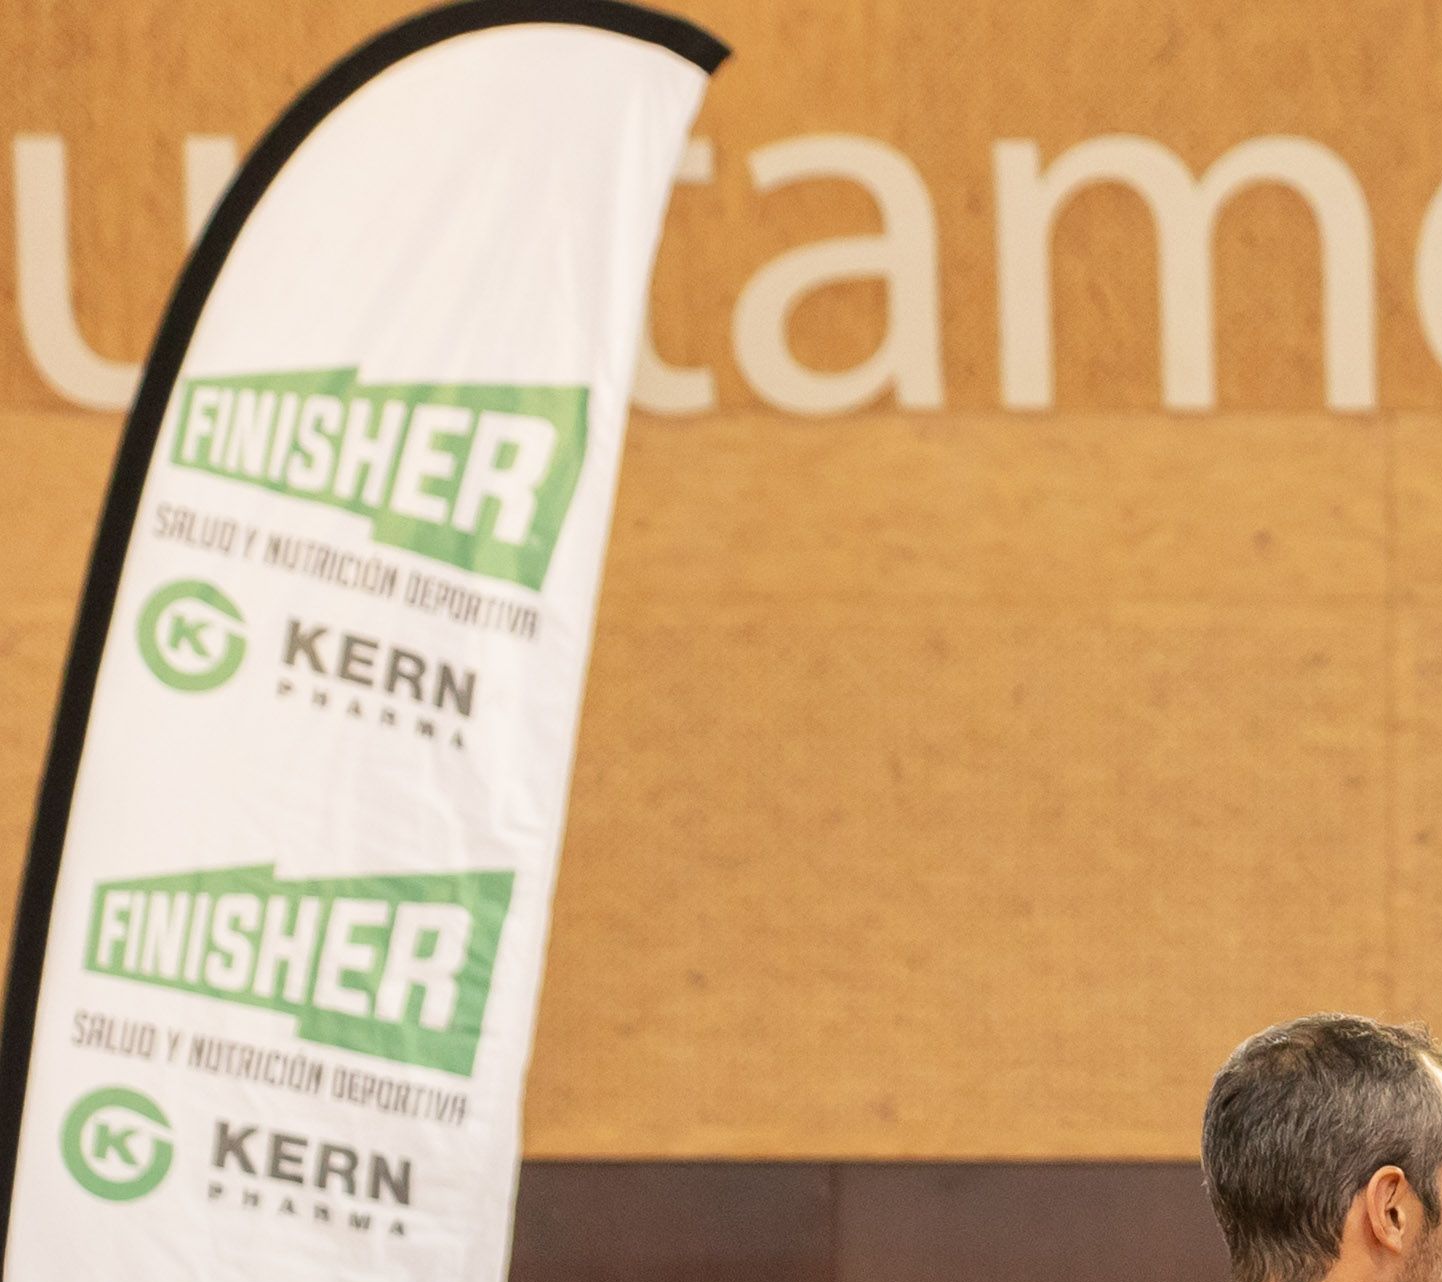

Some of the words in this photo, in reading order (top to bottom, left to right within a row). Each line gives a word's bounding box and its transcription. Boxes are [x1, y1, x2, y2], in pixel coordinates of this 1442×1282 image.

[181, 386, 557, 547] FINISHER
[154, 504, 240, 558] SALUD
[243, 526, 263, 560] Y
[406, 571, 540, 641] DEPORTIVA
[283, 617, 477, 719] KERN
[96, 887, 474, 1032] FINISHER
[70, 1010, 156, 1057] SALUD
[166, 1030, 183, 1062] Y
[332, 1067, 470, 1126] DEPORTIVA
[211, 1118, 413, 1207] KERN
